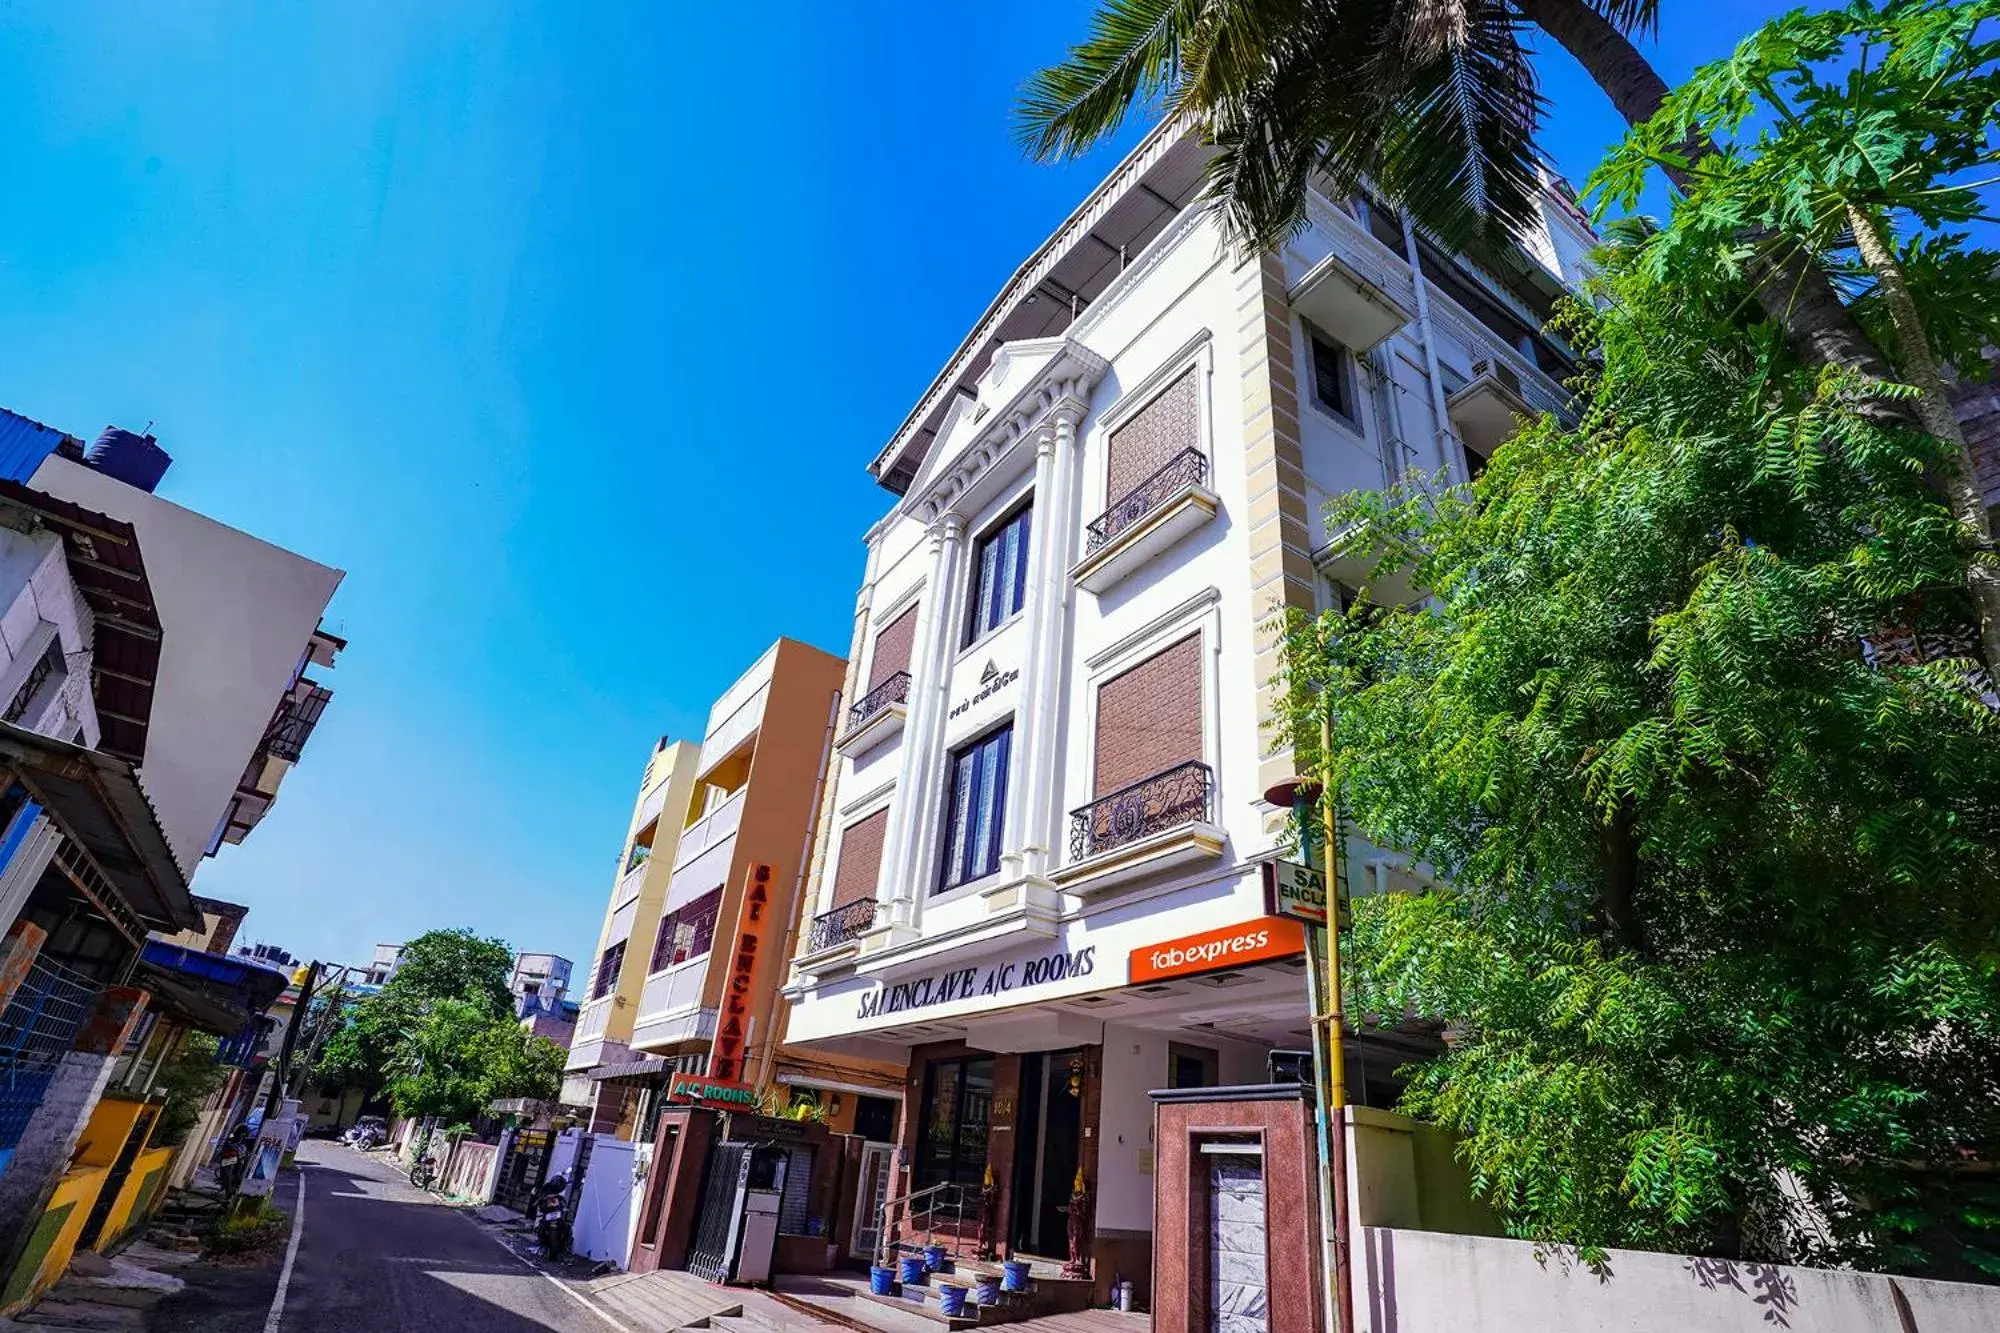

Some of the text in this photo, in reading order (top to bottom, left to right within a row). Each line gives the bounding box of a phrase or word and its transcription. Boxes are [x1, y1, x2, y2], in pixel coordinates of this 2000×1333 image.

[1279, 883, 1349, 913] ENCLAE
[1150, 929, 1269, 970] fabexpress
[716, 864, 771, 1080] SAI ENCLAVE
[857, 946, 1097, 1019] SAI ENCLAVE A/C ROOMS
[703, 1084, 753, 1104] ROOMS
